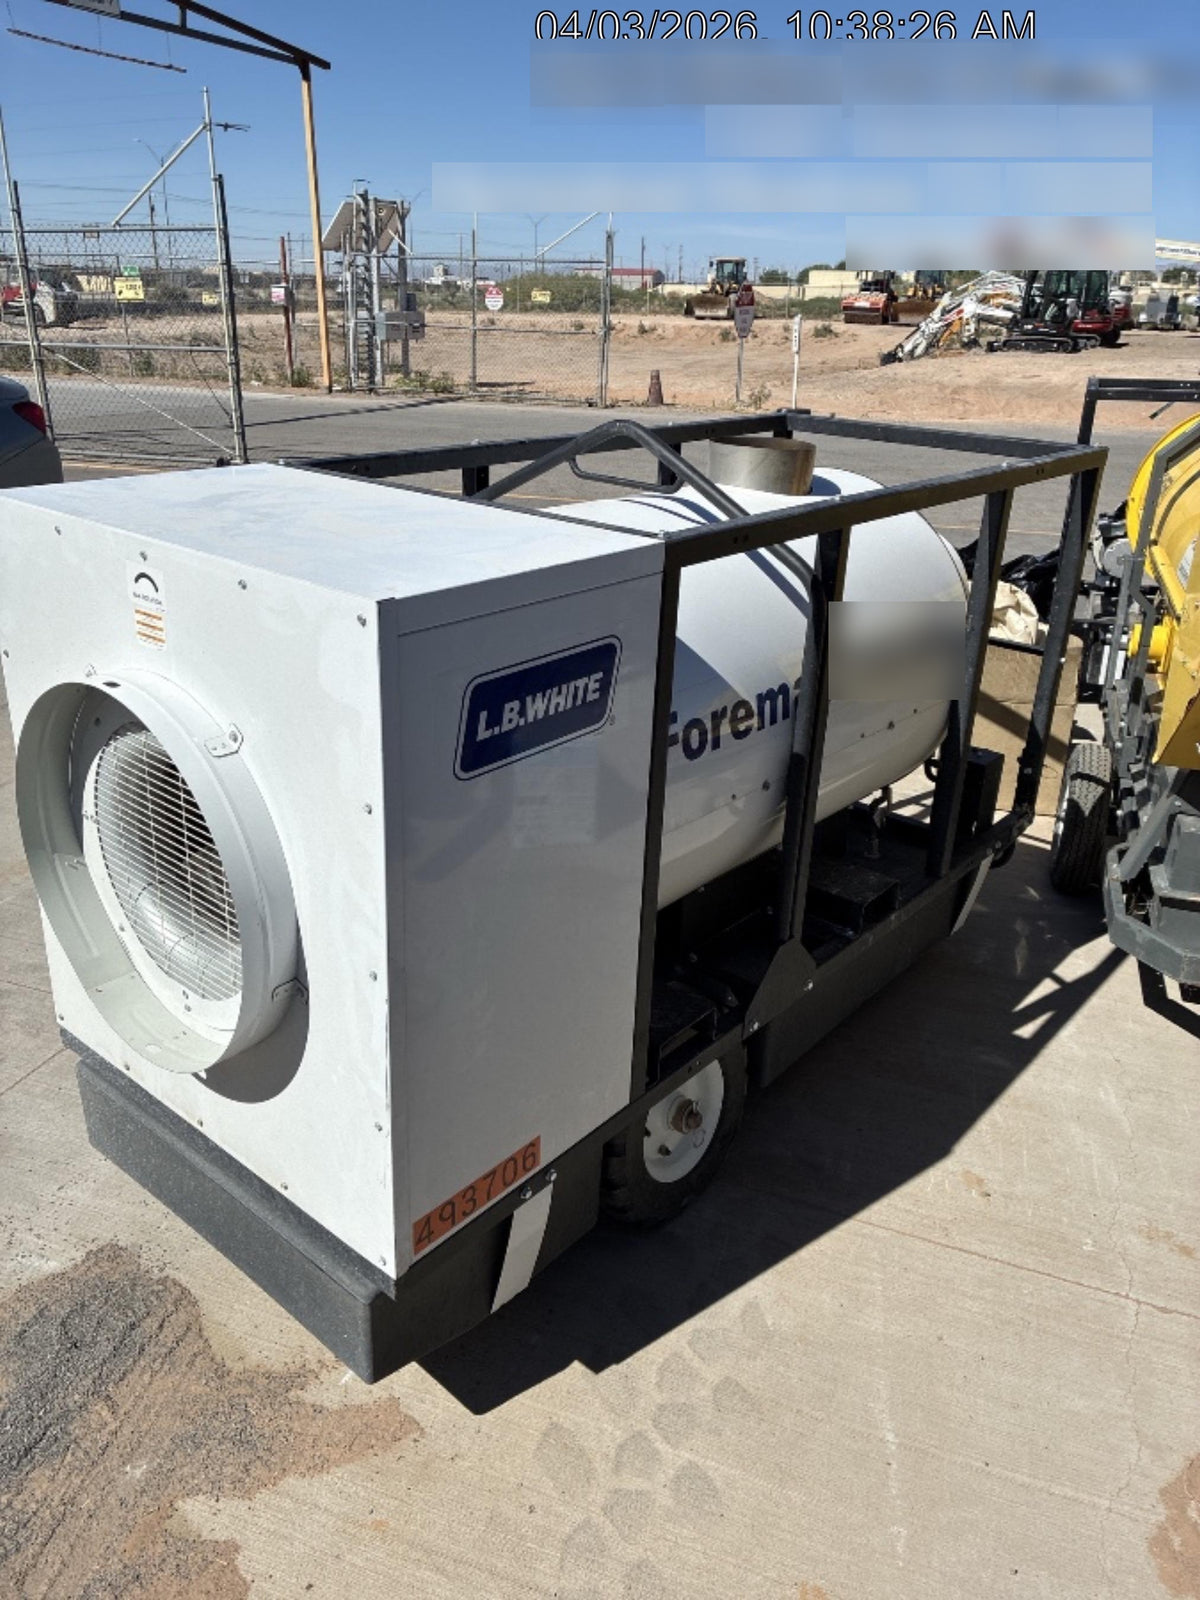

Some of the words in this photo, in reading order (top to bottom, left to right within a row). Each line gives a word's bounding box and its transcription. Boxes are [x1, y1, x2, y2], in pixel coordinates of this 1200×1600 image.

[476, 671, 604, 741] L.B.WHITE
[667, 677, 802, 761] Forem
[414, 1141, 537, 1247] 493706
